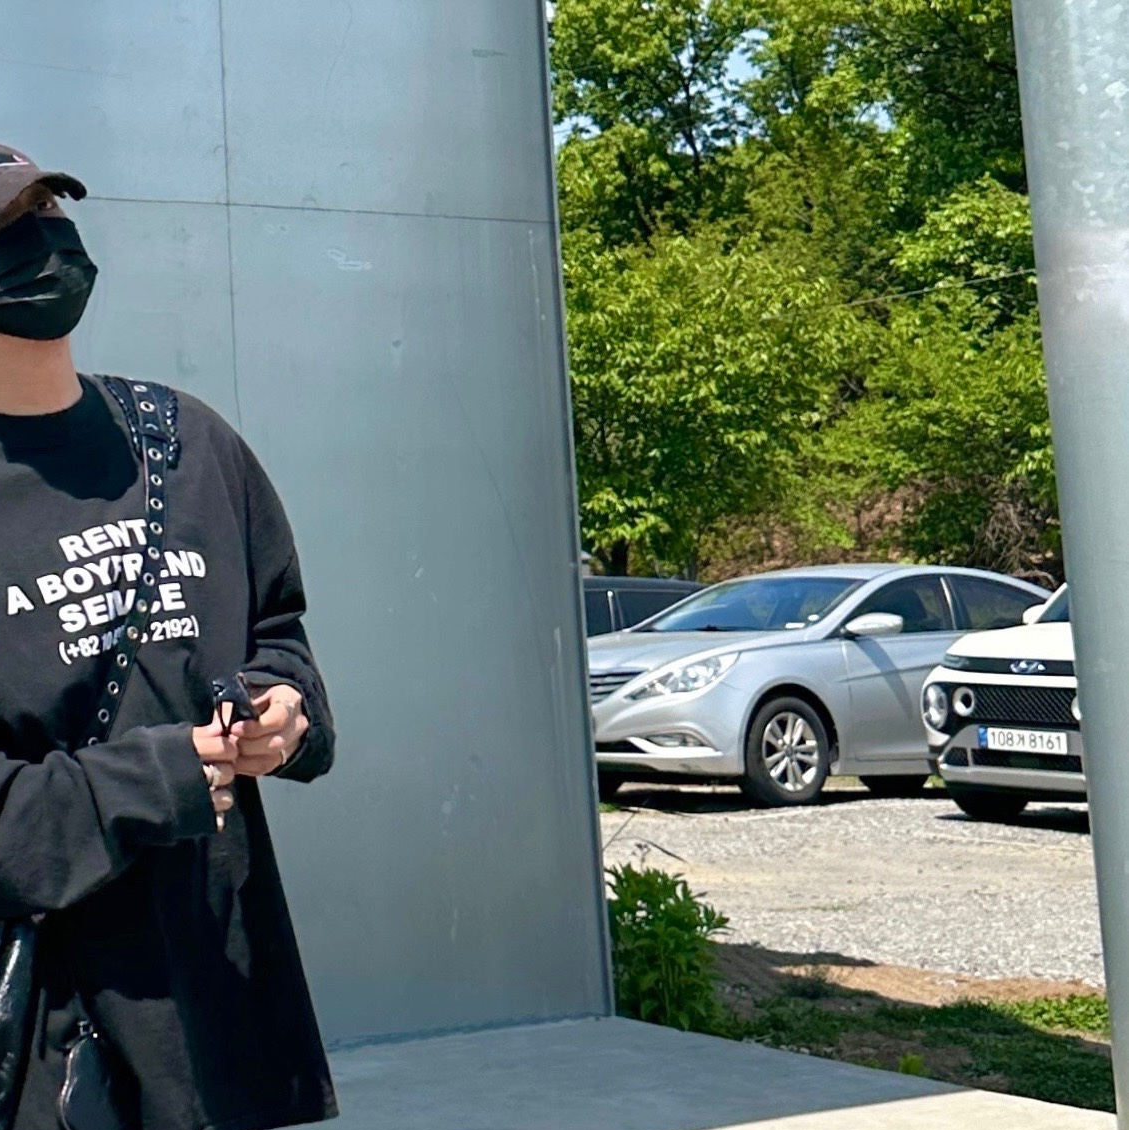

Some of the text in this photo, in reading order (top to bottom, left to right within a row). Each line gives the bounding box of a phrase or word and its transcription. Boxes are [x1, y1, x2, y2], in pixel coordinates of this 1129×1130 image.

[58, 518, 148, 562] RENT
[6, 551, 206, 615] A BOYFRND
[58, 582, 186, 633] SEVE
[58, 634, 100, 665] (+82
[151, 615, 200, 642] 2192)
[1028, 732, 1063, 751] 8161
